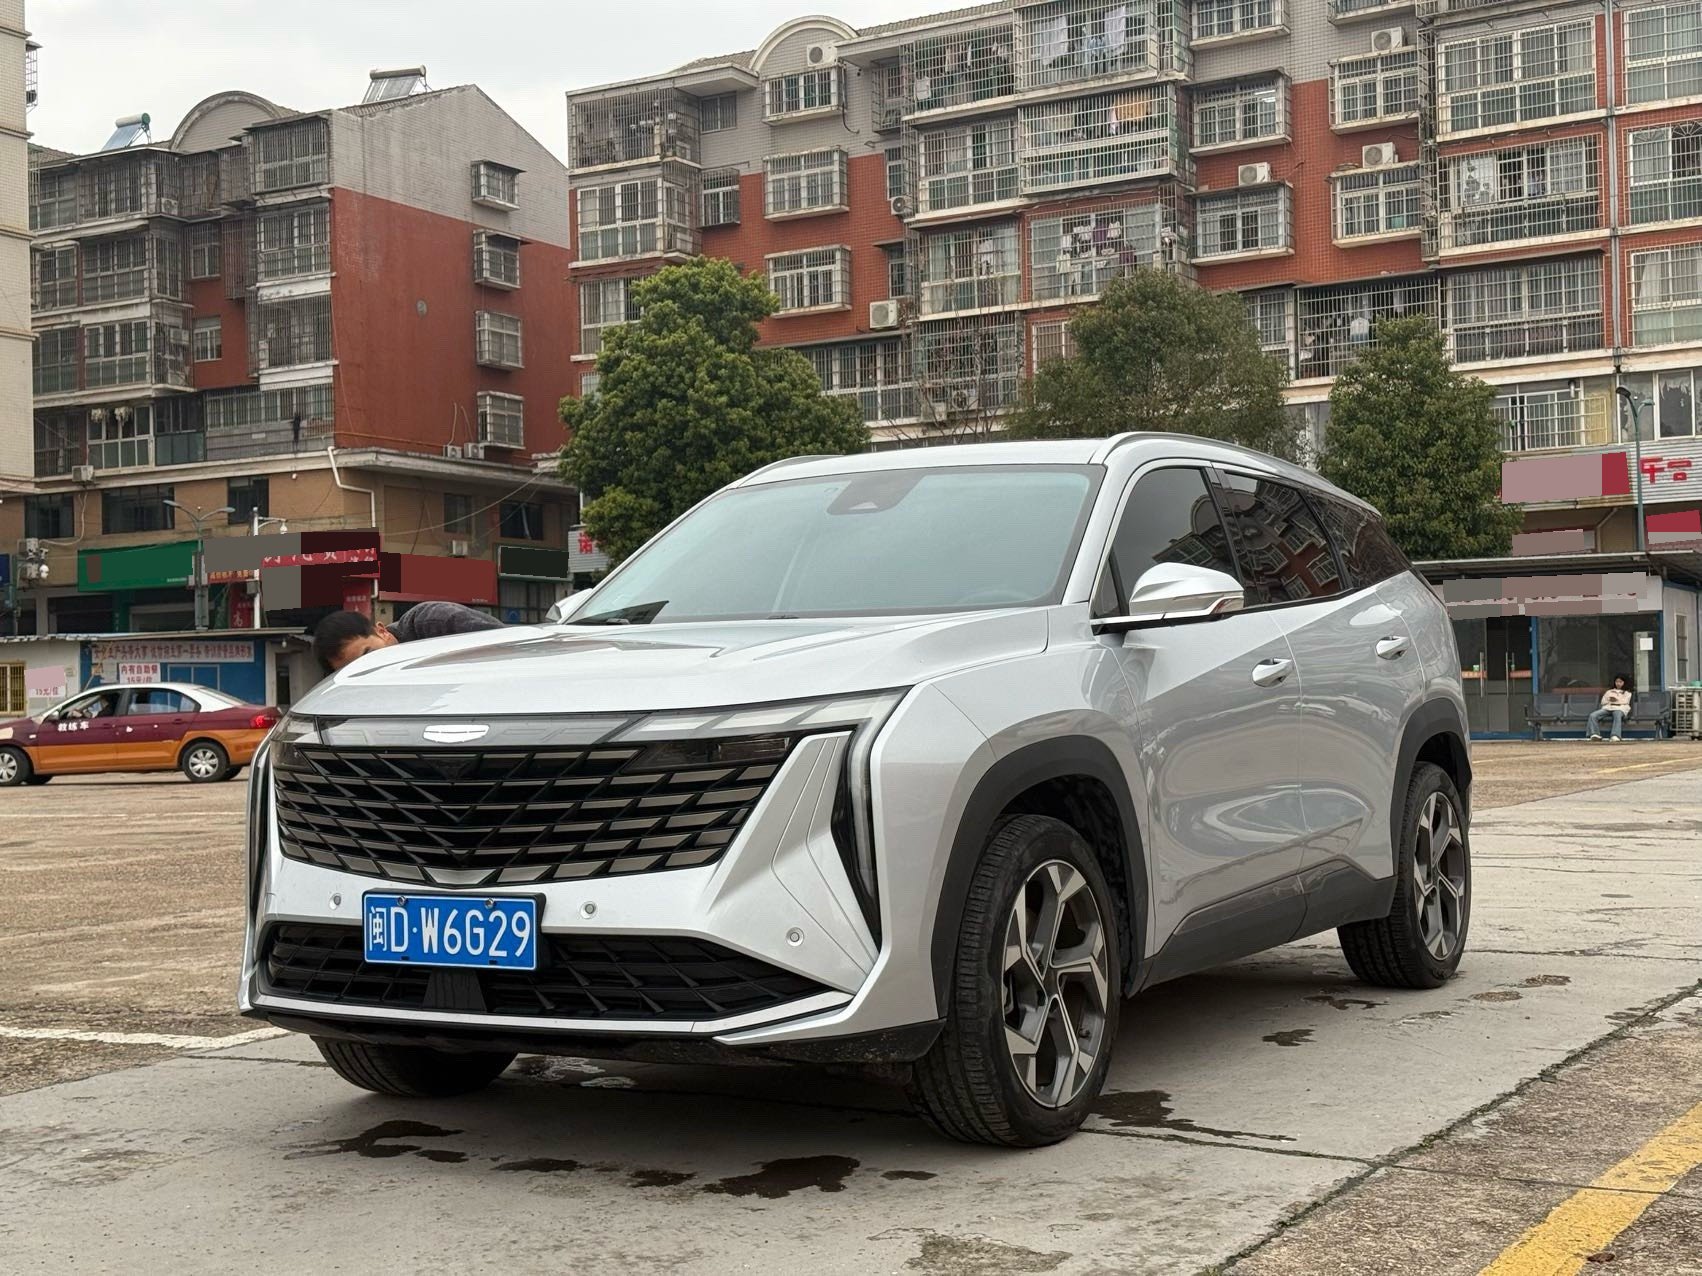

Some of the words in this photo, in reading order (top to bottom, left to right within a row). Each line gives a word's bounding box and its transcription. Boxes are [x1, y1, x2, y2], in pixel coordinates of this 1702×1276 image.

[121, 664, 158, 675] 内有自助餐
[57, 721, 90, 732] 教练车
[369, 905, 531, 958] 闽D·W6G29
